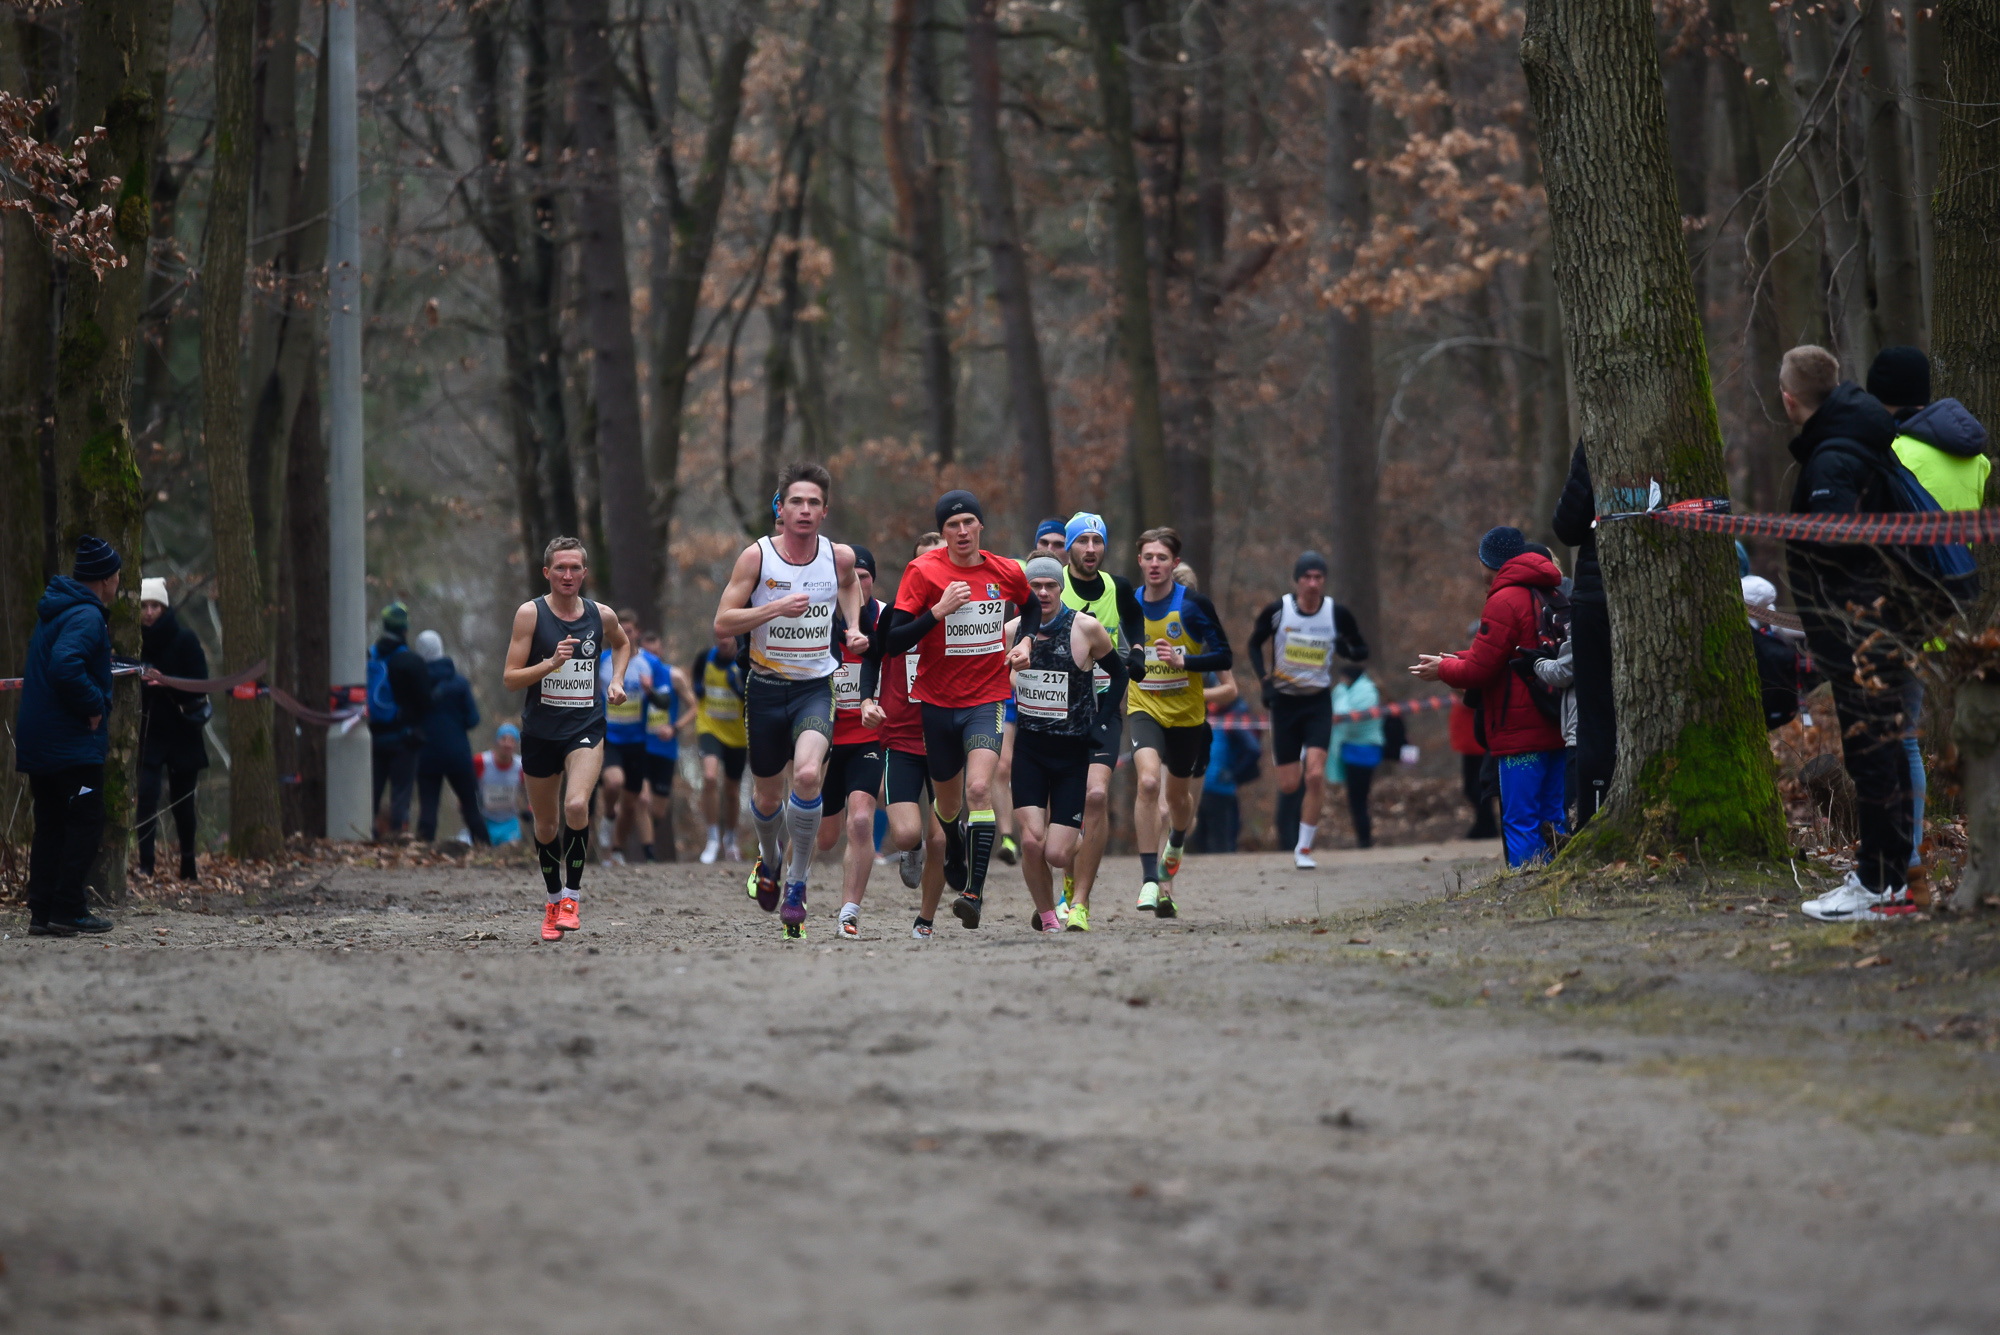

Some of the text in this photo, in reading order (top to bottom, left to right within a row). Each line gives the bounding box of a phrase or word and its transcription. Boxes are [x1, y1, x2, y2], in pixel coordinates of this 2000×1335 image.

[804, 605, 829, 618] 200
[978, 601, 1002, 615] 392
[769, 625, 829, 639] KOZŁOWSKI
[947, 621, 1002, 636] DOBROWOLSKI
[573, 661, 593, 672] 143
[543, 678, 593, 690] STYPUŁKOWSKI
[1042, 672, 1066, 684] 217
[835, 682, 861, 693] ACZM
[1018, 686, 1067, 702] MIELEWCZYK
[1019, 707, 1039, 715] TOMASZÓW
